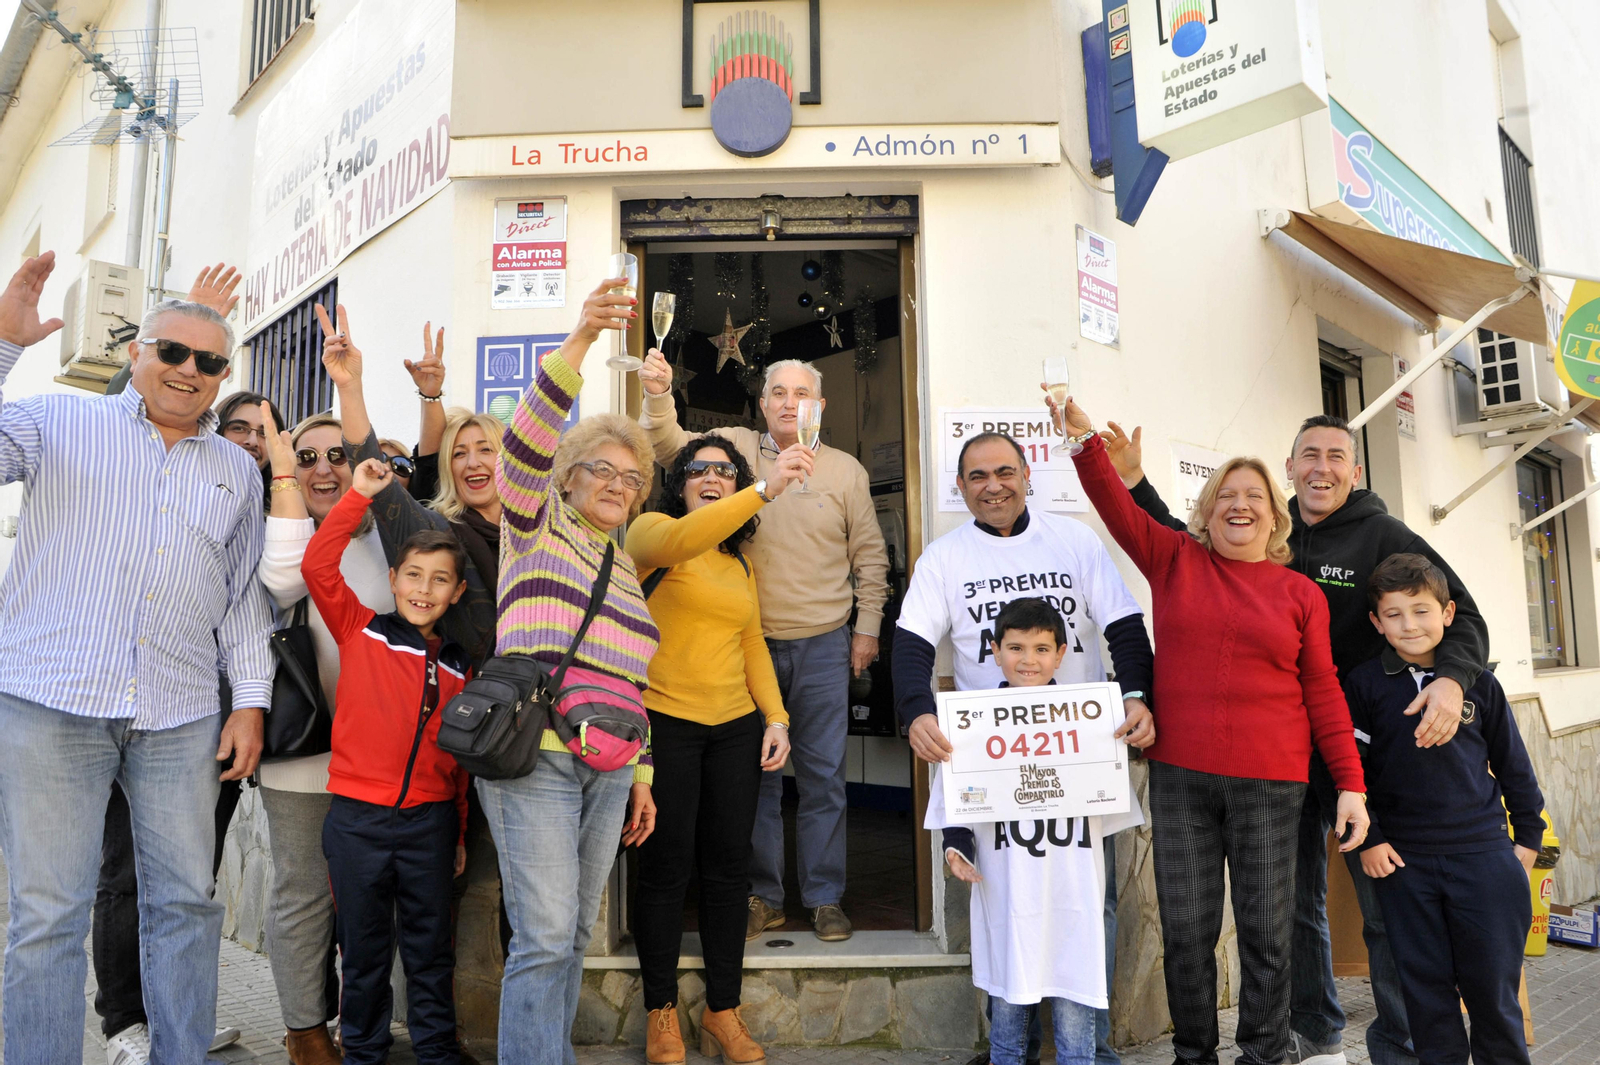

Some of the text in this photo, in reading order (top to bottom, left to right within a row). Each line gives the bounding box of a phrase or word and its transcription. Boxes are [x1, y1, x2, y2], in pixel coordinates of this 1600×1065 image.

[1162, 43, 1239, 83] Loterías y
[1164, 47, 1267, 100] Apuestas del
[337, 42, 426, 145] Apuestas
[1164, 89, 1218, 118] Estado
[322, 130, 336, 170] y
[511, 140, 648, 166] La Trucha
[852, 133, 1028, 156] Admón nº 1
[245, 112, 451, 326] HAY LOTERIA DE NAVIDAD
[506, 216, 556, 238] Direct
[497, 245, 562, 260] Alarma
[538, 259, 562, 267] Policía
[1084, 253, 1111, 268] Direct
[1081, 276, 1116, 302] Alarma
[1180, 460, 1192, 475] SE
[989, 572, 1072, 593] PREMIO
[956, 700, 1102, 730] 3er PREMIO
[985, 729, 1080, 760] 04211
[1020, 774, 1061, 791] PREMIO ES
[1014, 788, 1065, 805] COMPARTIRLO
